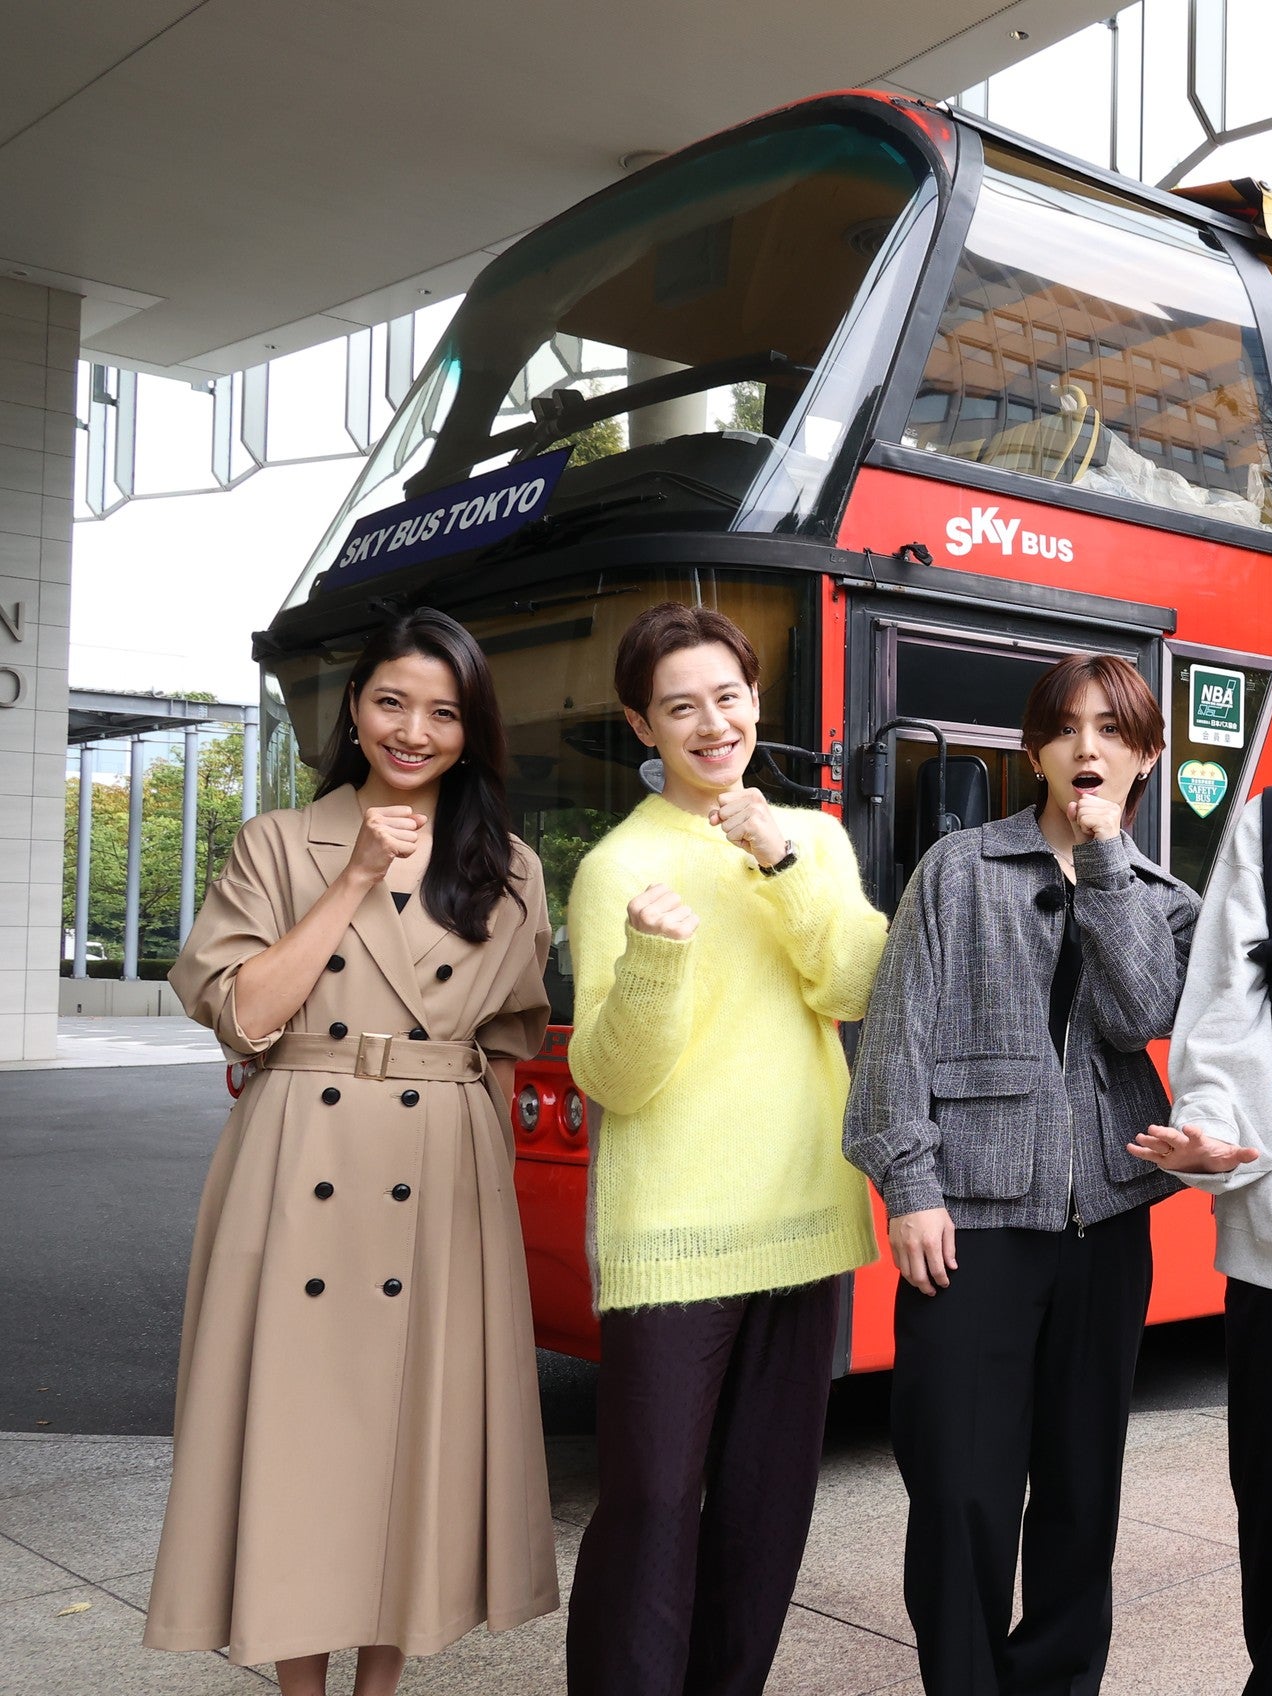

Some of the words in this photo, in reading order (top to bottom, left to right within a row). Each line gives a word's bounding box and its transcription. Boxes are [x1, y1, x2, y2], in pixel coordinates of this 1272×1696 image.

[340, 525, 393, 568] SKY
[387, 508, 445, 552] BUS
[443, 478, 546, 535] TOKYO
[945, 506, 1021, 556] SKY
[1021, 530, 1074, 563] BUS
[1201, 684, 1234, 705] NBA
[1188, 784, 1217, 796] SAFETY
[1195, 793, 1211, 803] BUS
